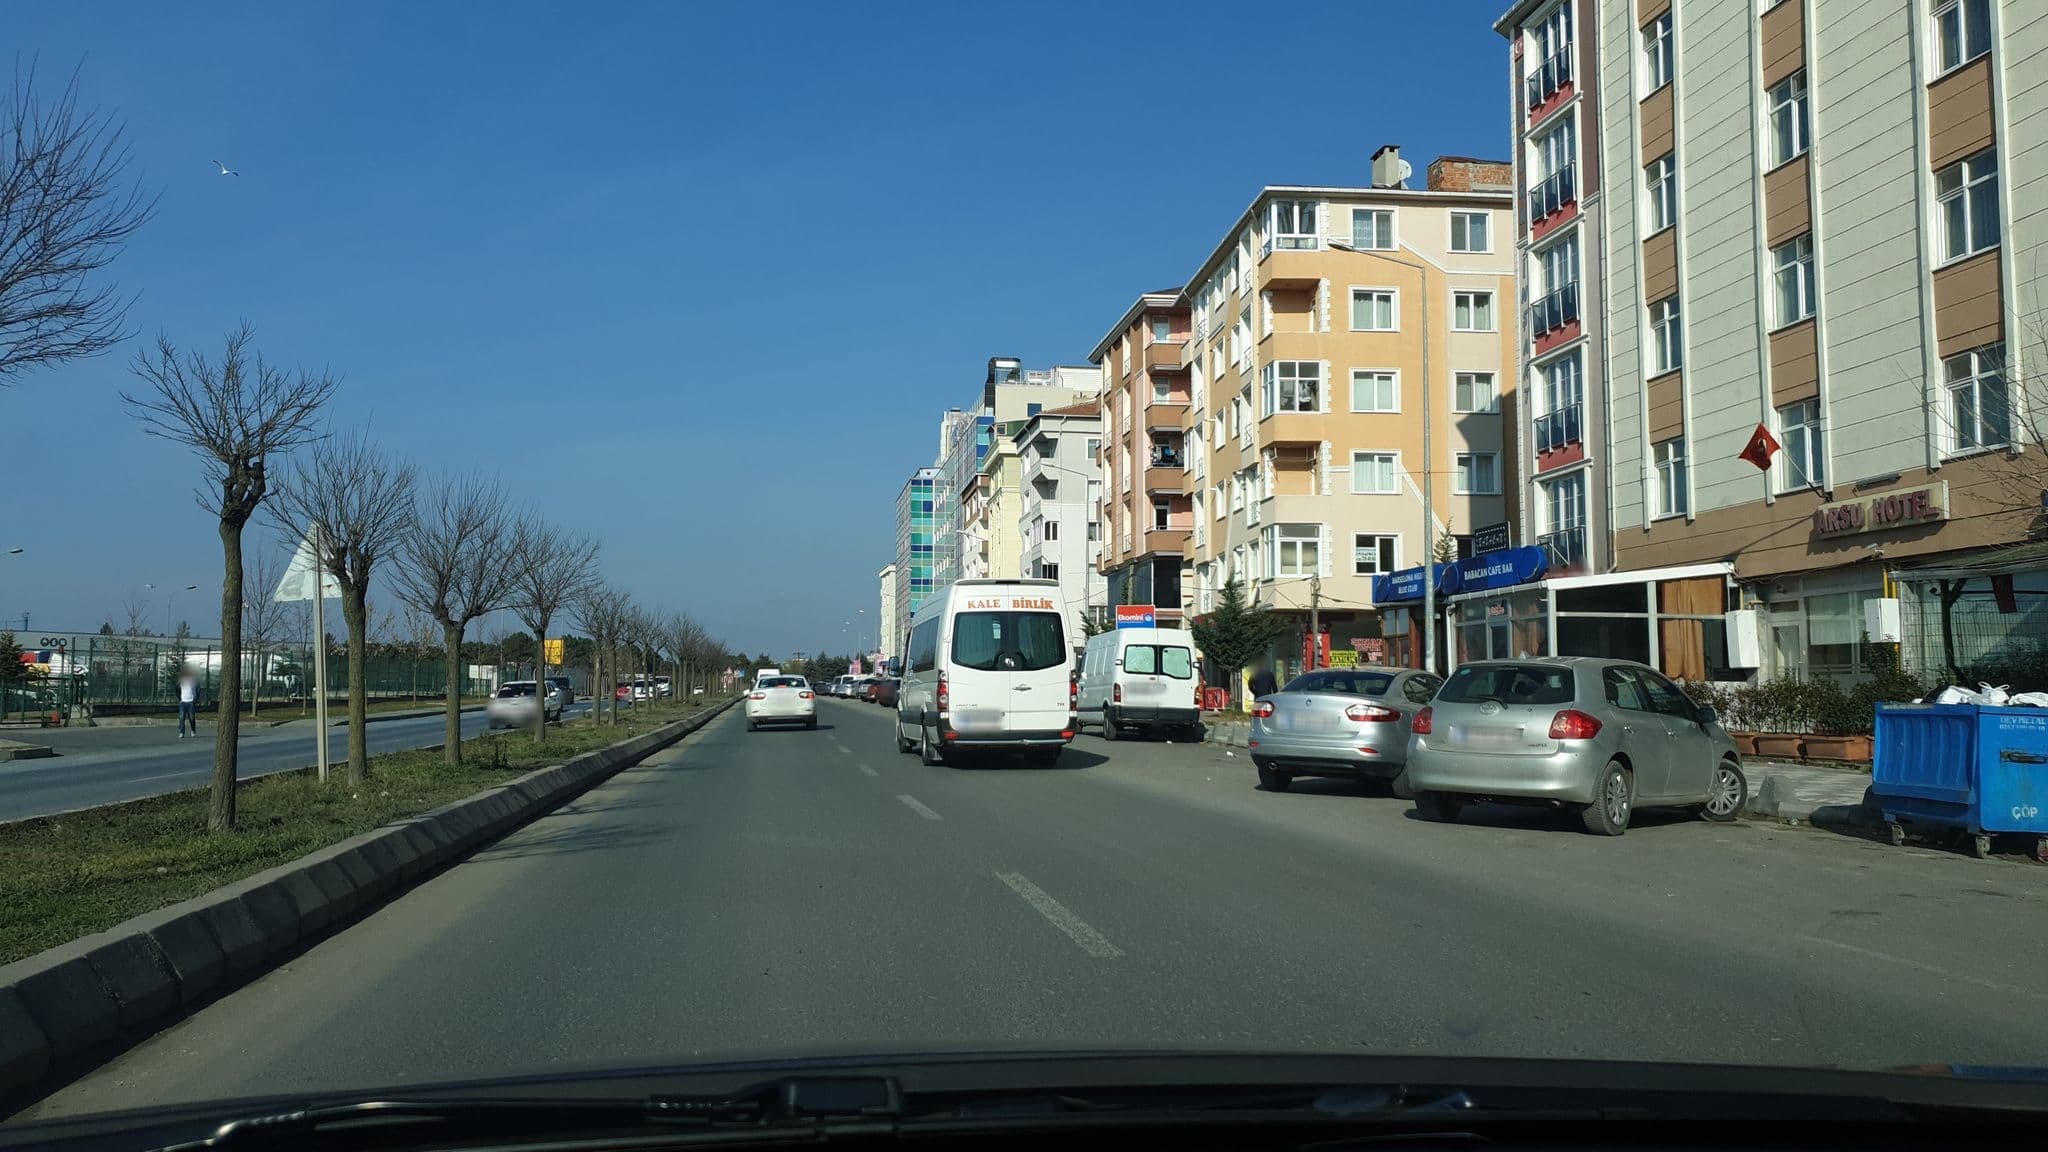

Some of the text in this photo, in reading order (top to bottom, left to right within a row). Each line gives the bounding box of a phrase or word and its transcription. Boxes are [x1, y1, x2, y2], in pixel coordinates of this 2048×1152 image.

[1816, 489, 1940, 533] ARSU HOTEL
[1464, 563, 1513, 580] BABACAN CAFE BAR
[967, 597, 1054, 609] KALE BİRLİK
[1119, 613, 1144, 621] Ekomini
[2012, 803, 2038, 820] ÇÖP
